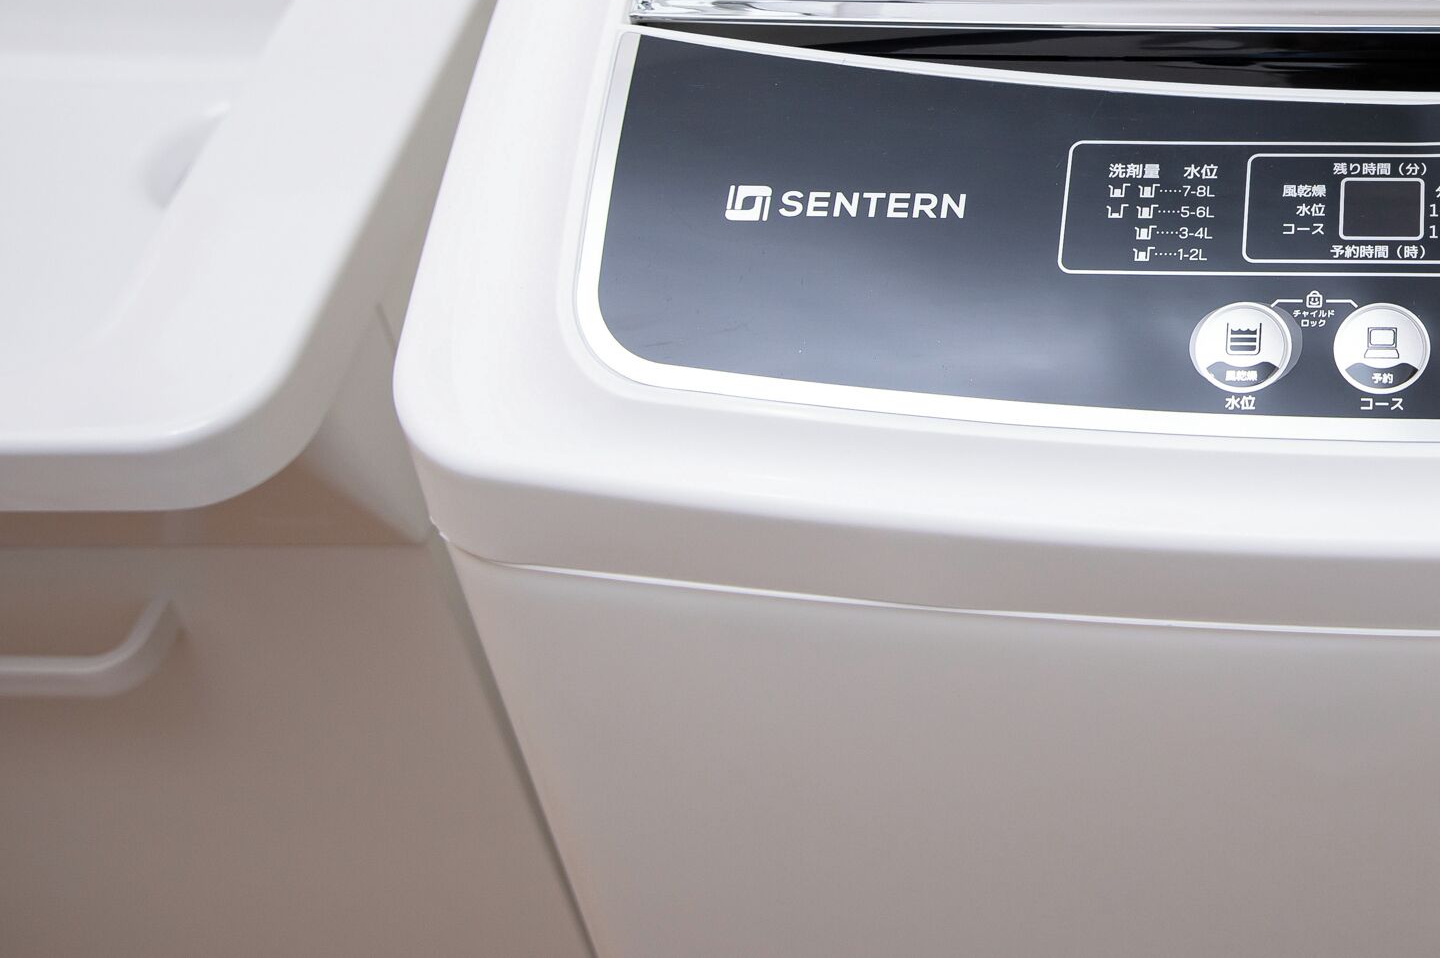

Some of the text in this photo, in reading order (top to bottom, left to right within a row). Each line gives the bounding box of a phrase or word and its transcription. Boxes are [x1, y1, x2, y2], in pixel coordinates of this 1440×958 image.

[1108, 163, 1219, 179] 洗剤量 水位
[1282, 184, 1327, 198] 風乾燥
[779, 191, 967, 218] SENTERN
[1296, 203, 1326, 217] 水位
[1282, 223, 1325, 236] コース
[1292, 309, 1335, 318] チャイルド
[1300, 319, 1327, 327] ロック
[1371, 372, 1394, 384] 予約
[1225, 395, 1256, 411] 水位
[1360, 398, 1404, 411] コース
